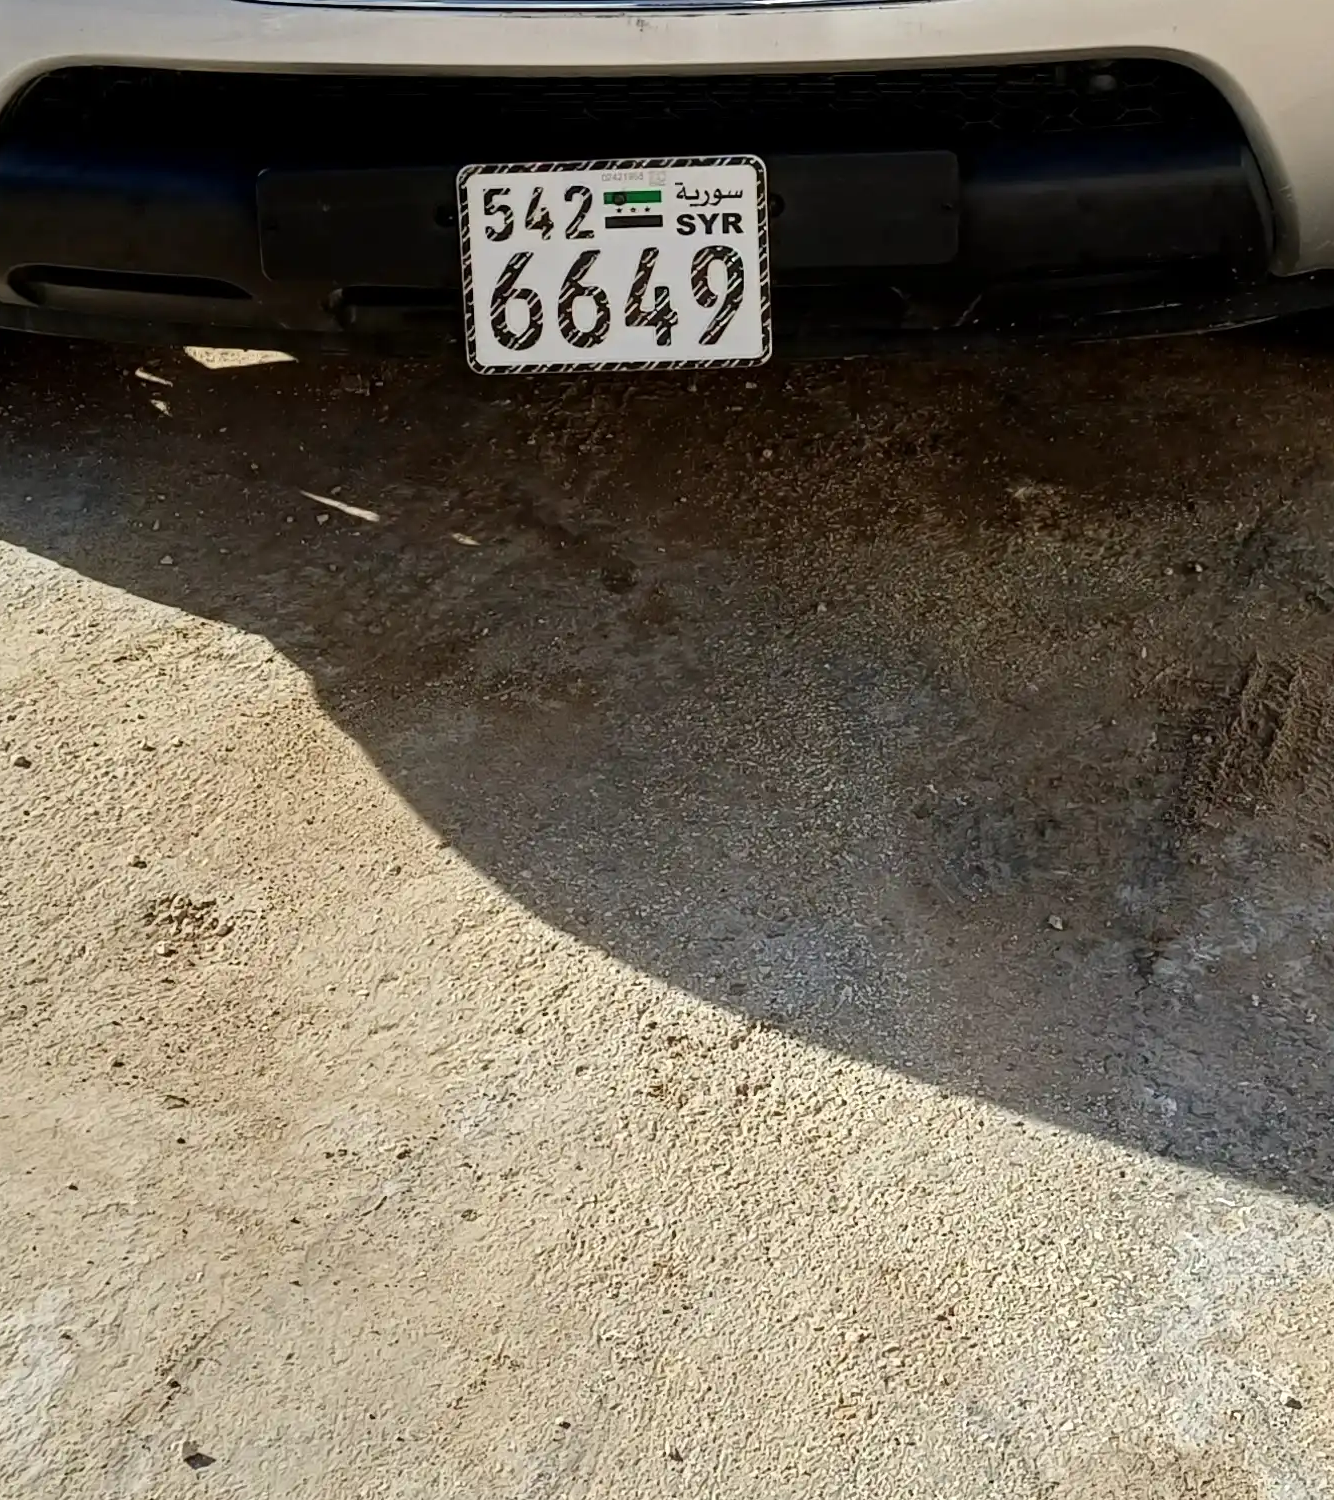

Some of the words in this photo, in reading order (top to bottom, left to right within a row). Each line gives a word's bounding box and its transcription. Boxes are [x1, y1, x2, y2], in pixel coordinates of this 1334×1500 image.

[482, 184, 596, 242] 542
[674, 181, 744, 208] سورية
[675, 212, 745, 236] SYR
[489, 244, 746, 351] 6649
